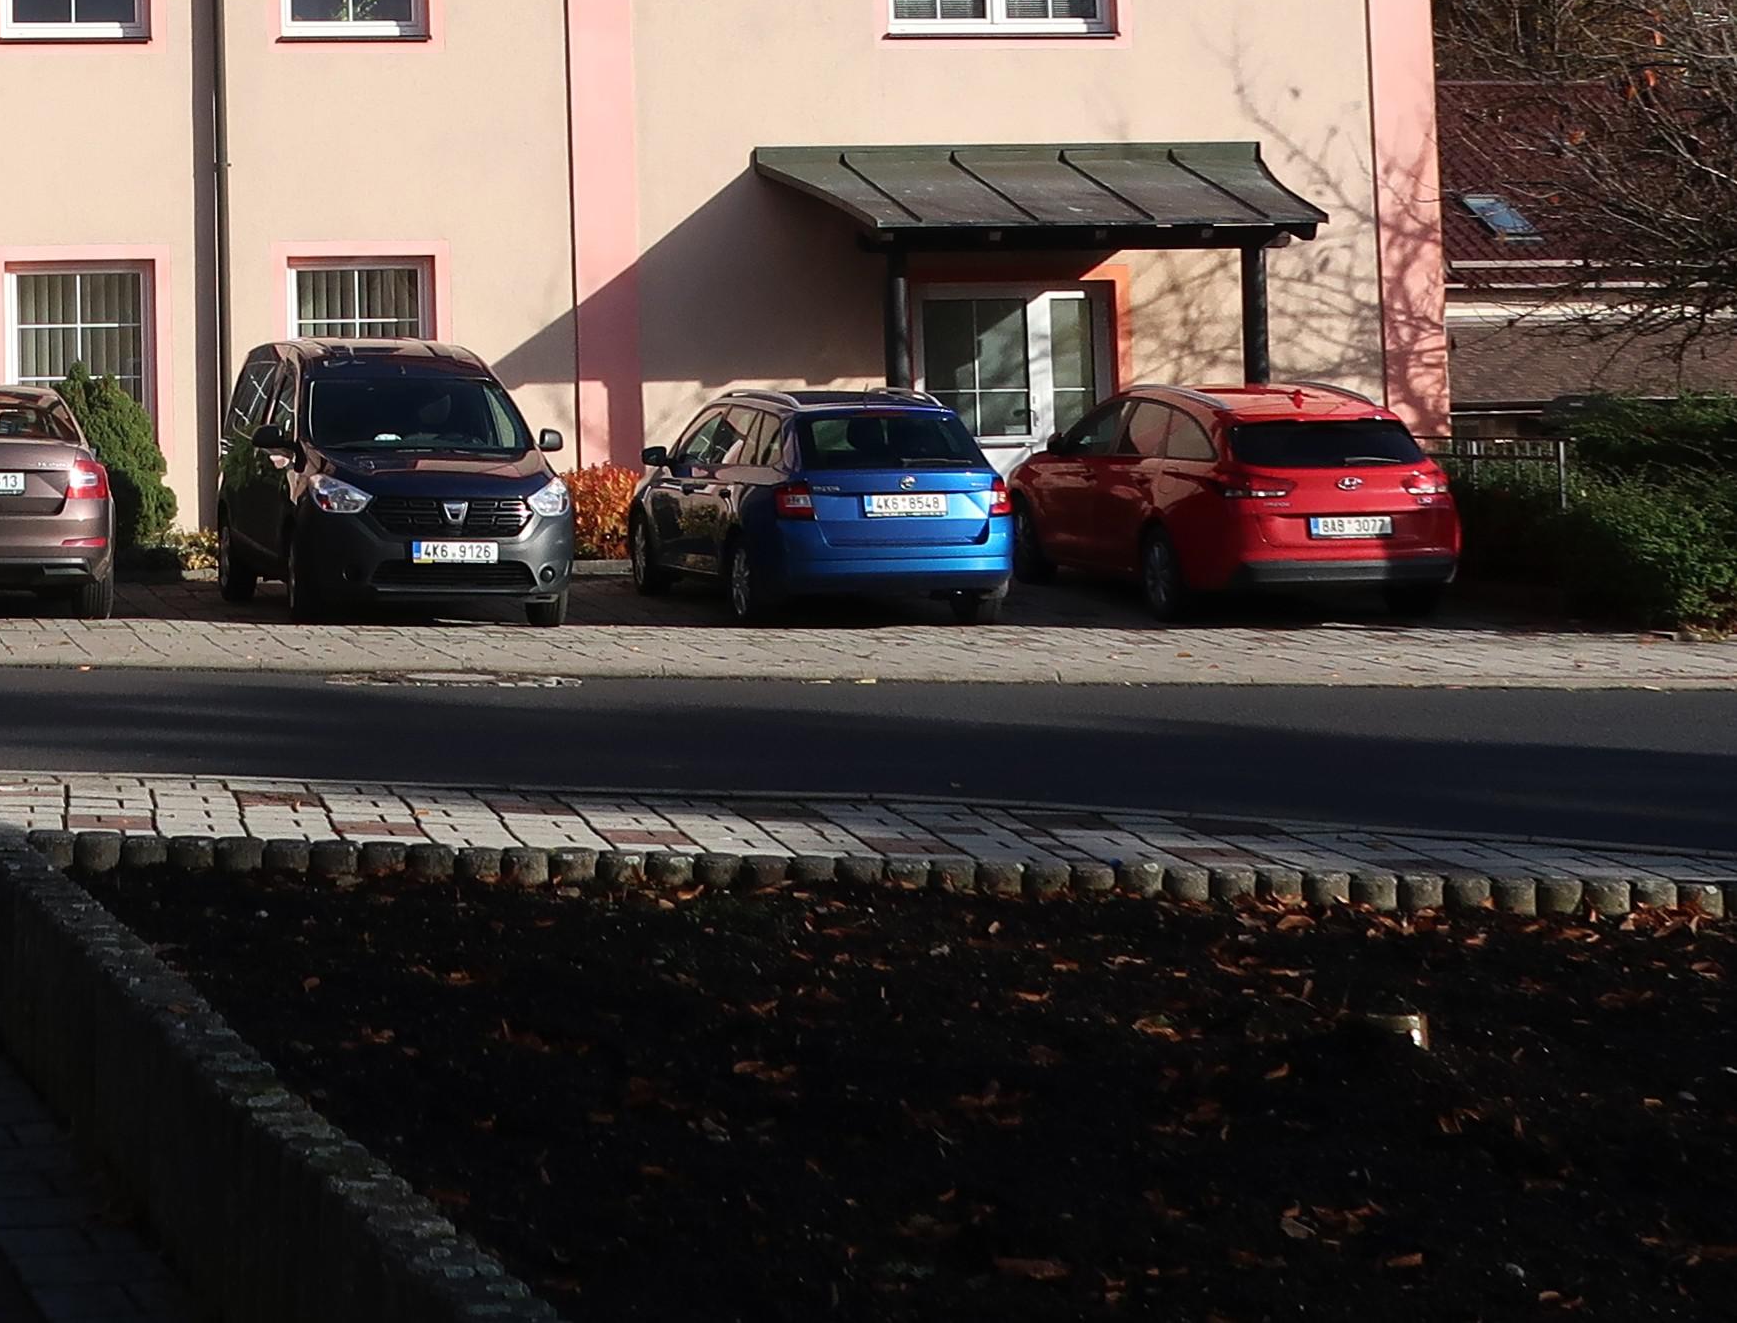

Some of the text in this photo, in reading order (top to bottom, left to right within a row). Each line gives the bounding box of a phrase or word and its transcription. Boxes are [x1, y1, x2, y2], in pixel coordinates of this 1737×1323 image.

[1354, 518, 1385, 532] 3077
[424, 544, 491, 558] 4K6 9126
